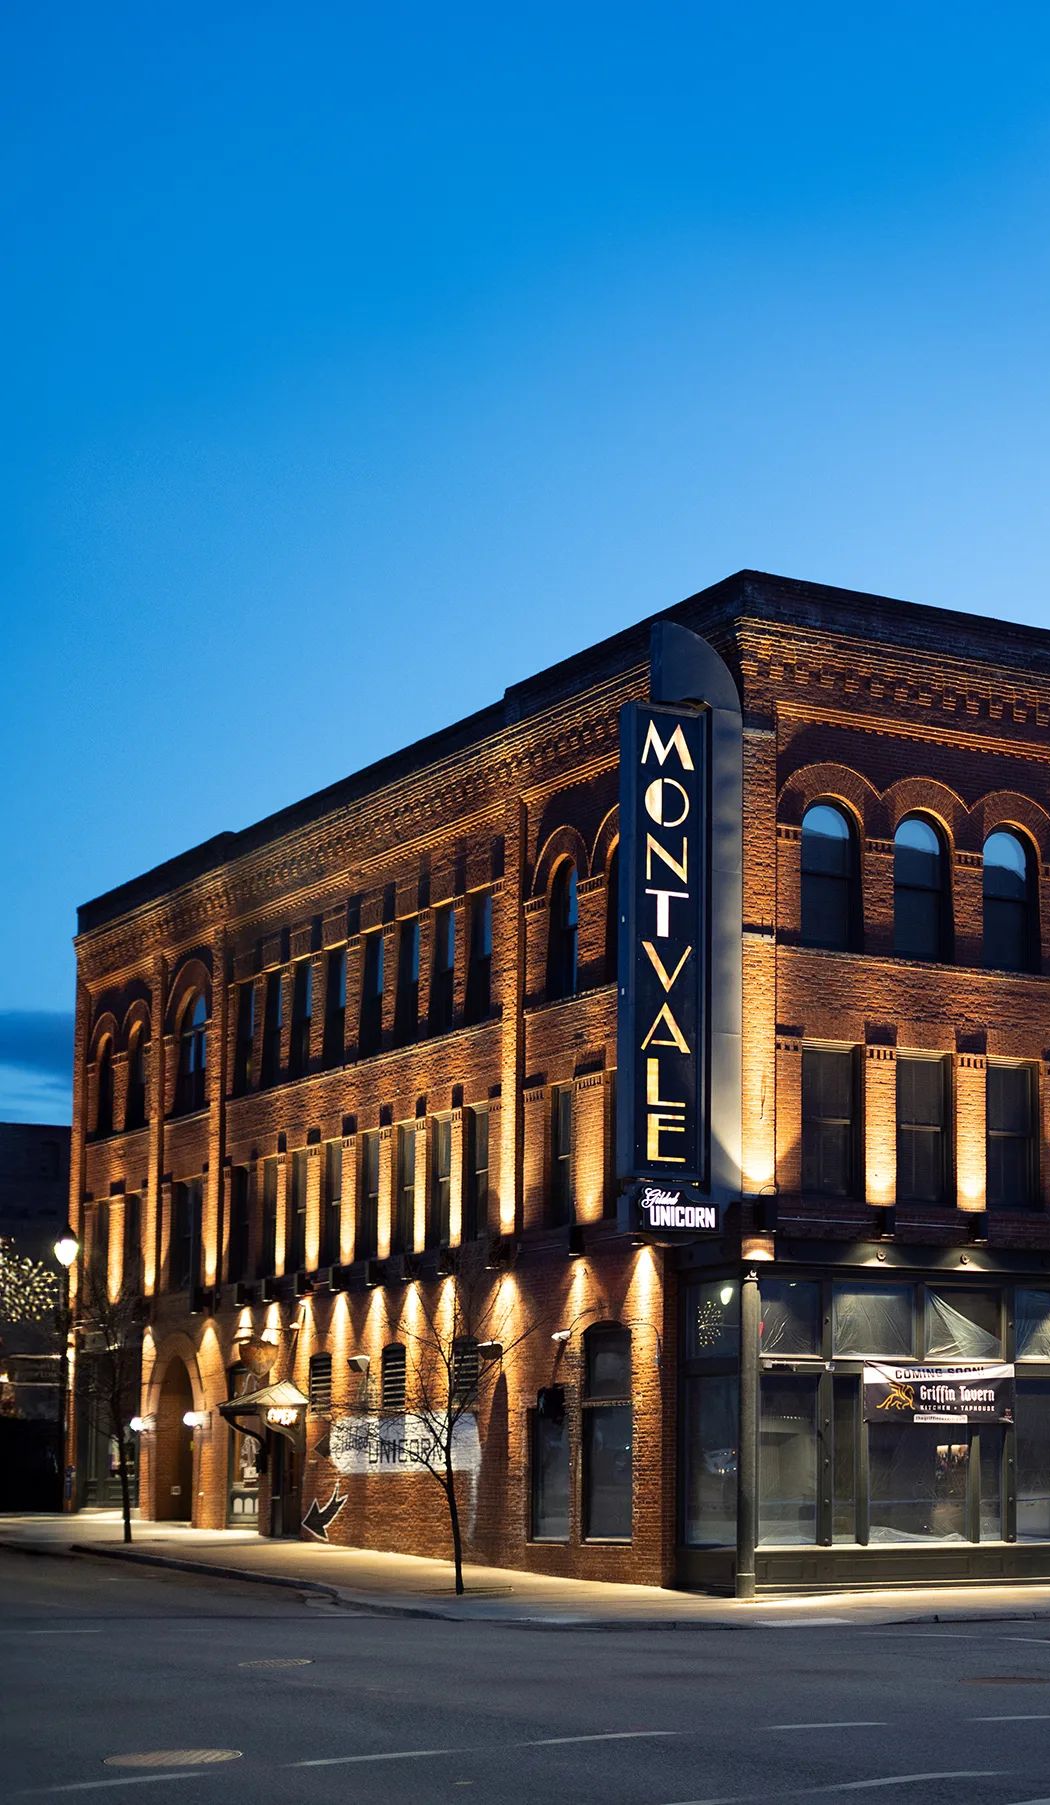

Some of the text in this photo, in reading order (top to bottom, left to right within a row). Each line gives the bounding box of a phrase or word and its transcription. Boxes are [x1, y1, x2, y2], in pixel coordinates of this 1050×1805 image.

[640, 719, 695, 1163] MONTVALE
[641, 1187, 680, 1208] Gilded
[649, 1205, 716, 1228] UNICORN
[895, 1366, 985, 1380] COMING SOON!
[920, 1385, 995, 1404] Griffin Tavern
